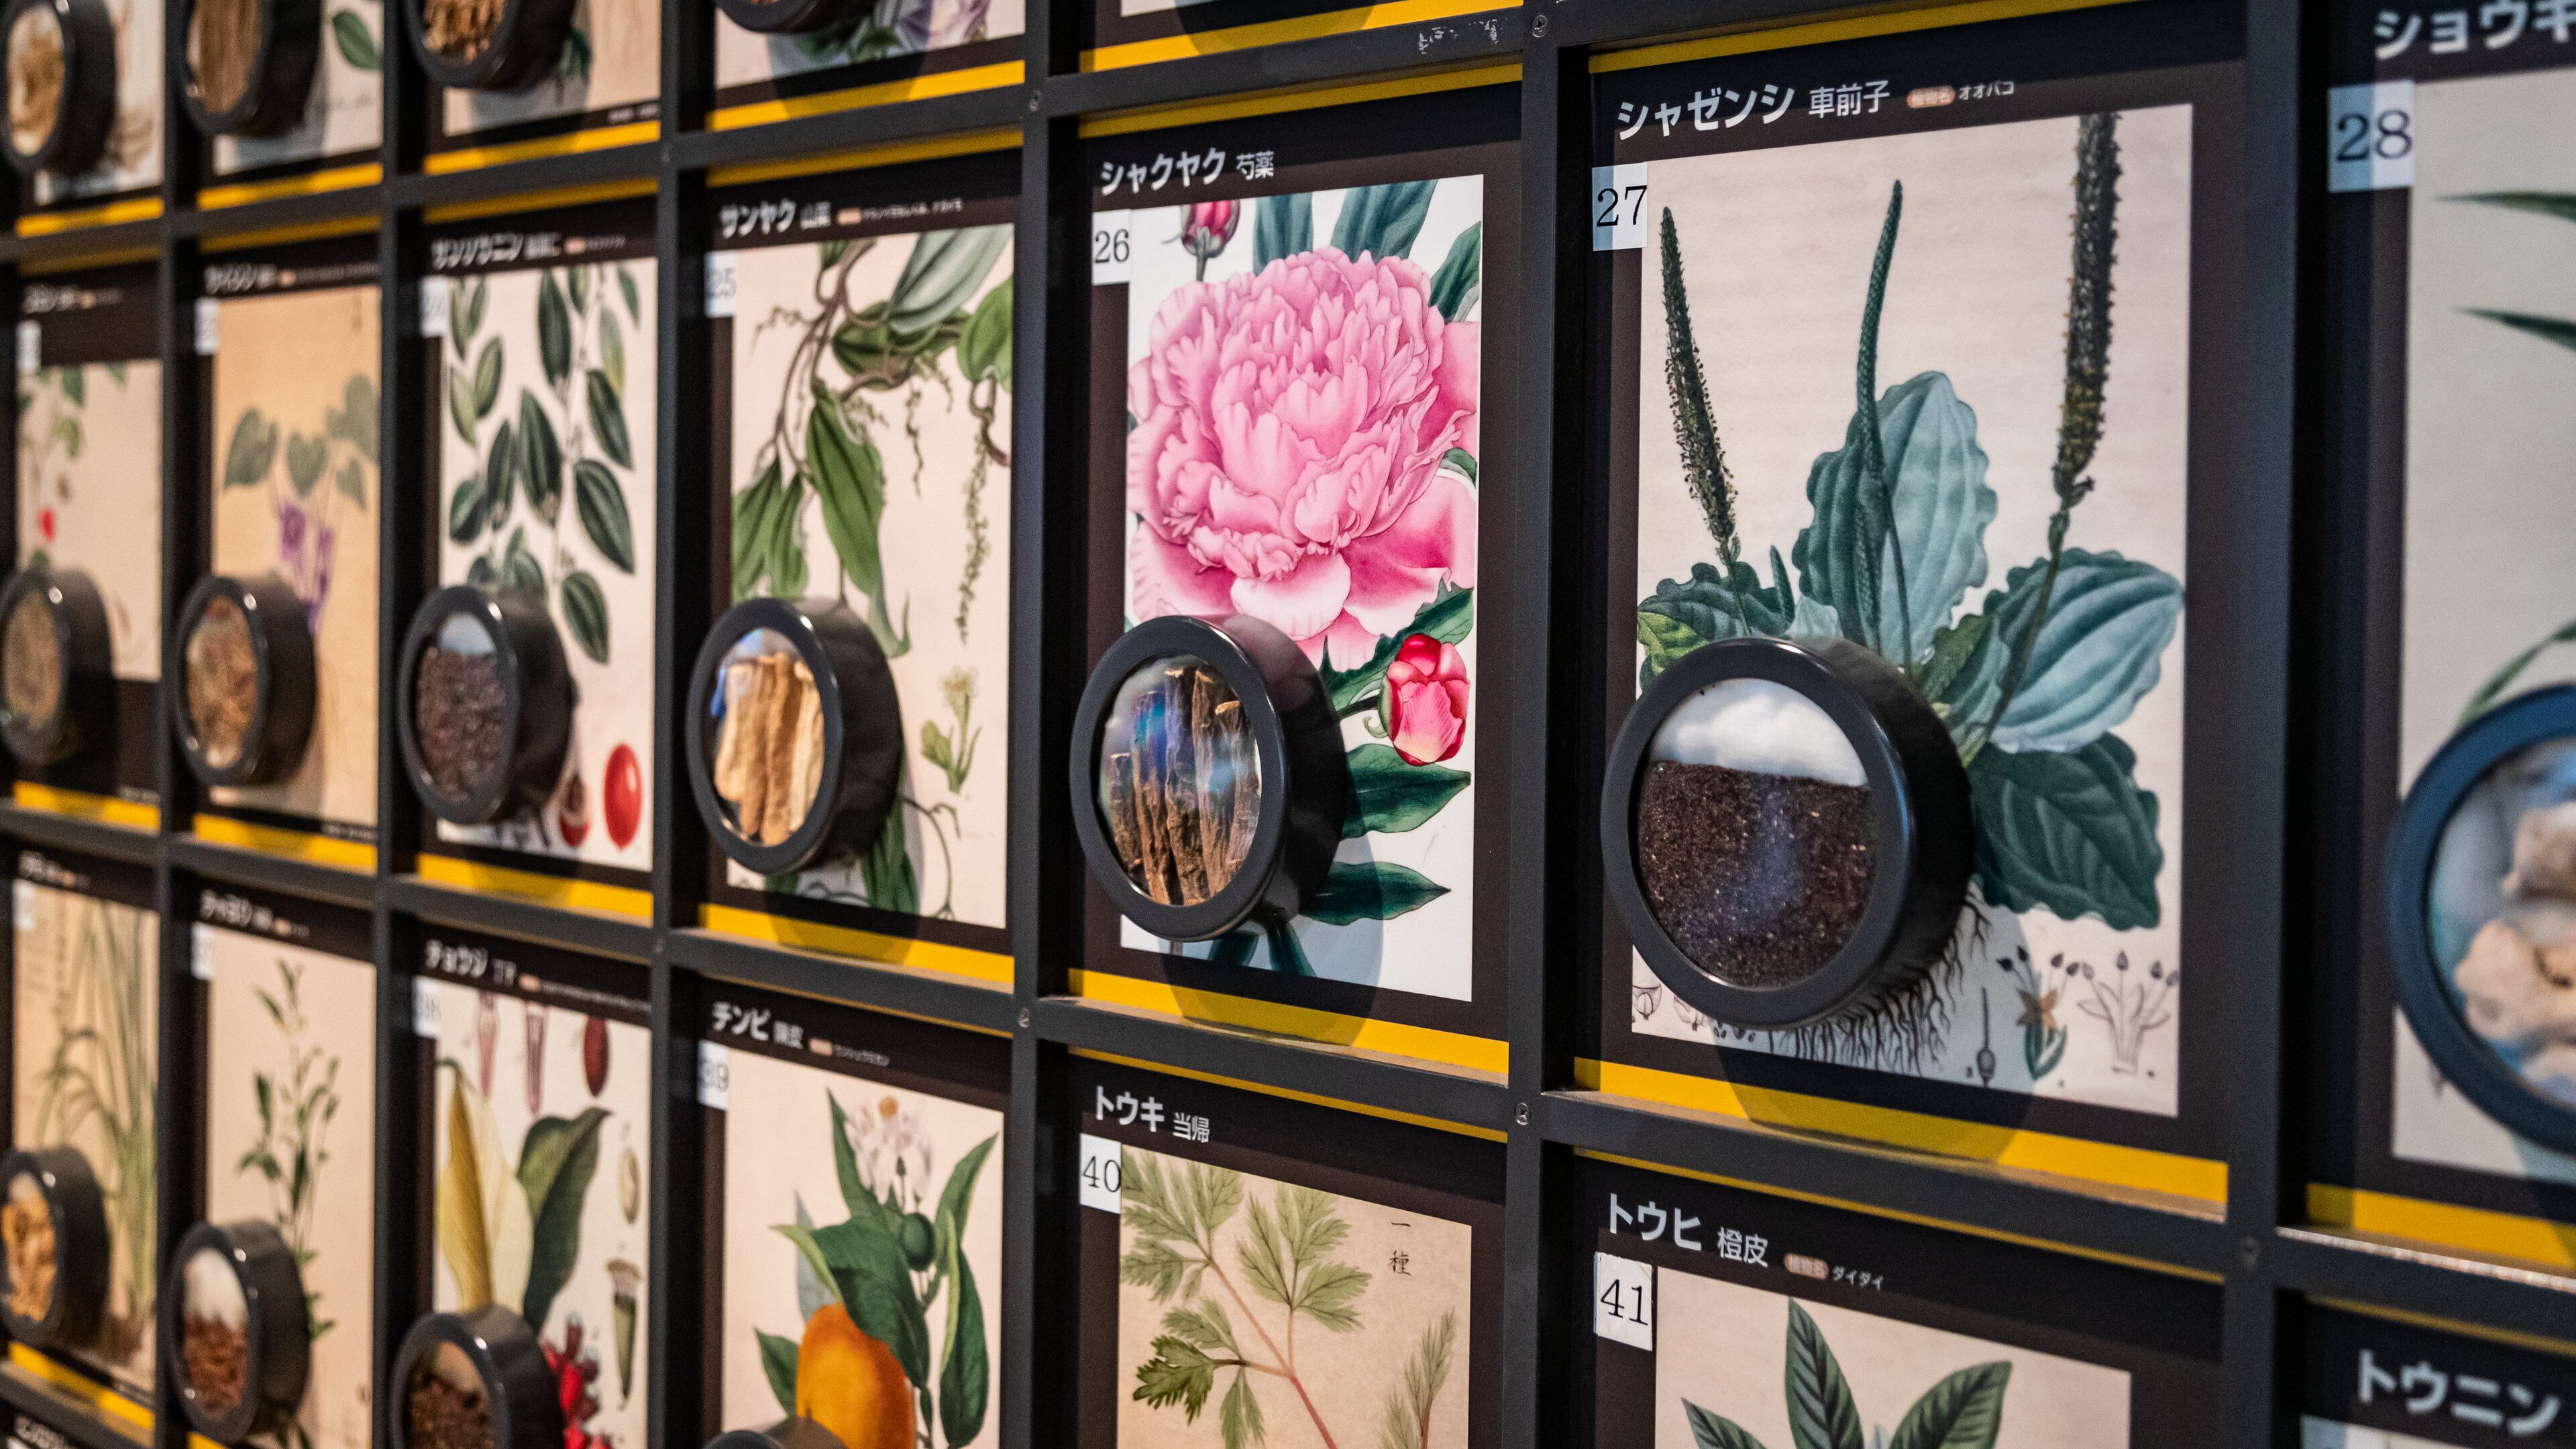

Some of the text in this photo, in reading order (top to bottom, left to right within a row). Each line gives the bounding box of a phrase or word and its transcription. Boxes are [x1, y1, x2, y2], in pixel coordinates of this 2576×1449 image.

[1617, 83, 1794, 141] シャゼンシ
[1808, 79, 1891, 119] 車前子
[1957, 80, 2015, 100] オオバコ
[2336, 109, 2413, 162] 28
[1100, 147, 1275, 196] シャクヤク 芍薬
[719, 197, 796, 238] サンヤク
[1596, 184, 1648, 227] 27
[1095, 228, 1130, 264] 26
[711, 1000, 771, 1040] チンピ
[1094, 1084, 1211, 1144] トウキ 当帰
[1082, 1155, 1122, 1194] 40
[1388, 1222, 1412, 1276] 一種
[1609, 1192, 1703, 1251] トウヒ
[1716, 1226, 1768, 1269] 橙皮
[1600, 1278, 1649, 1326] 41
[2358, 1347, 2562, 1438] トウニン
